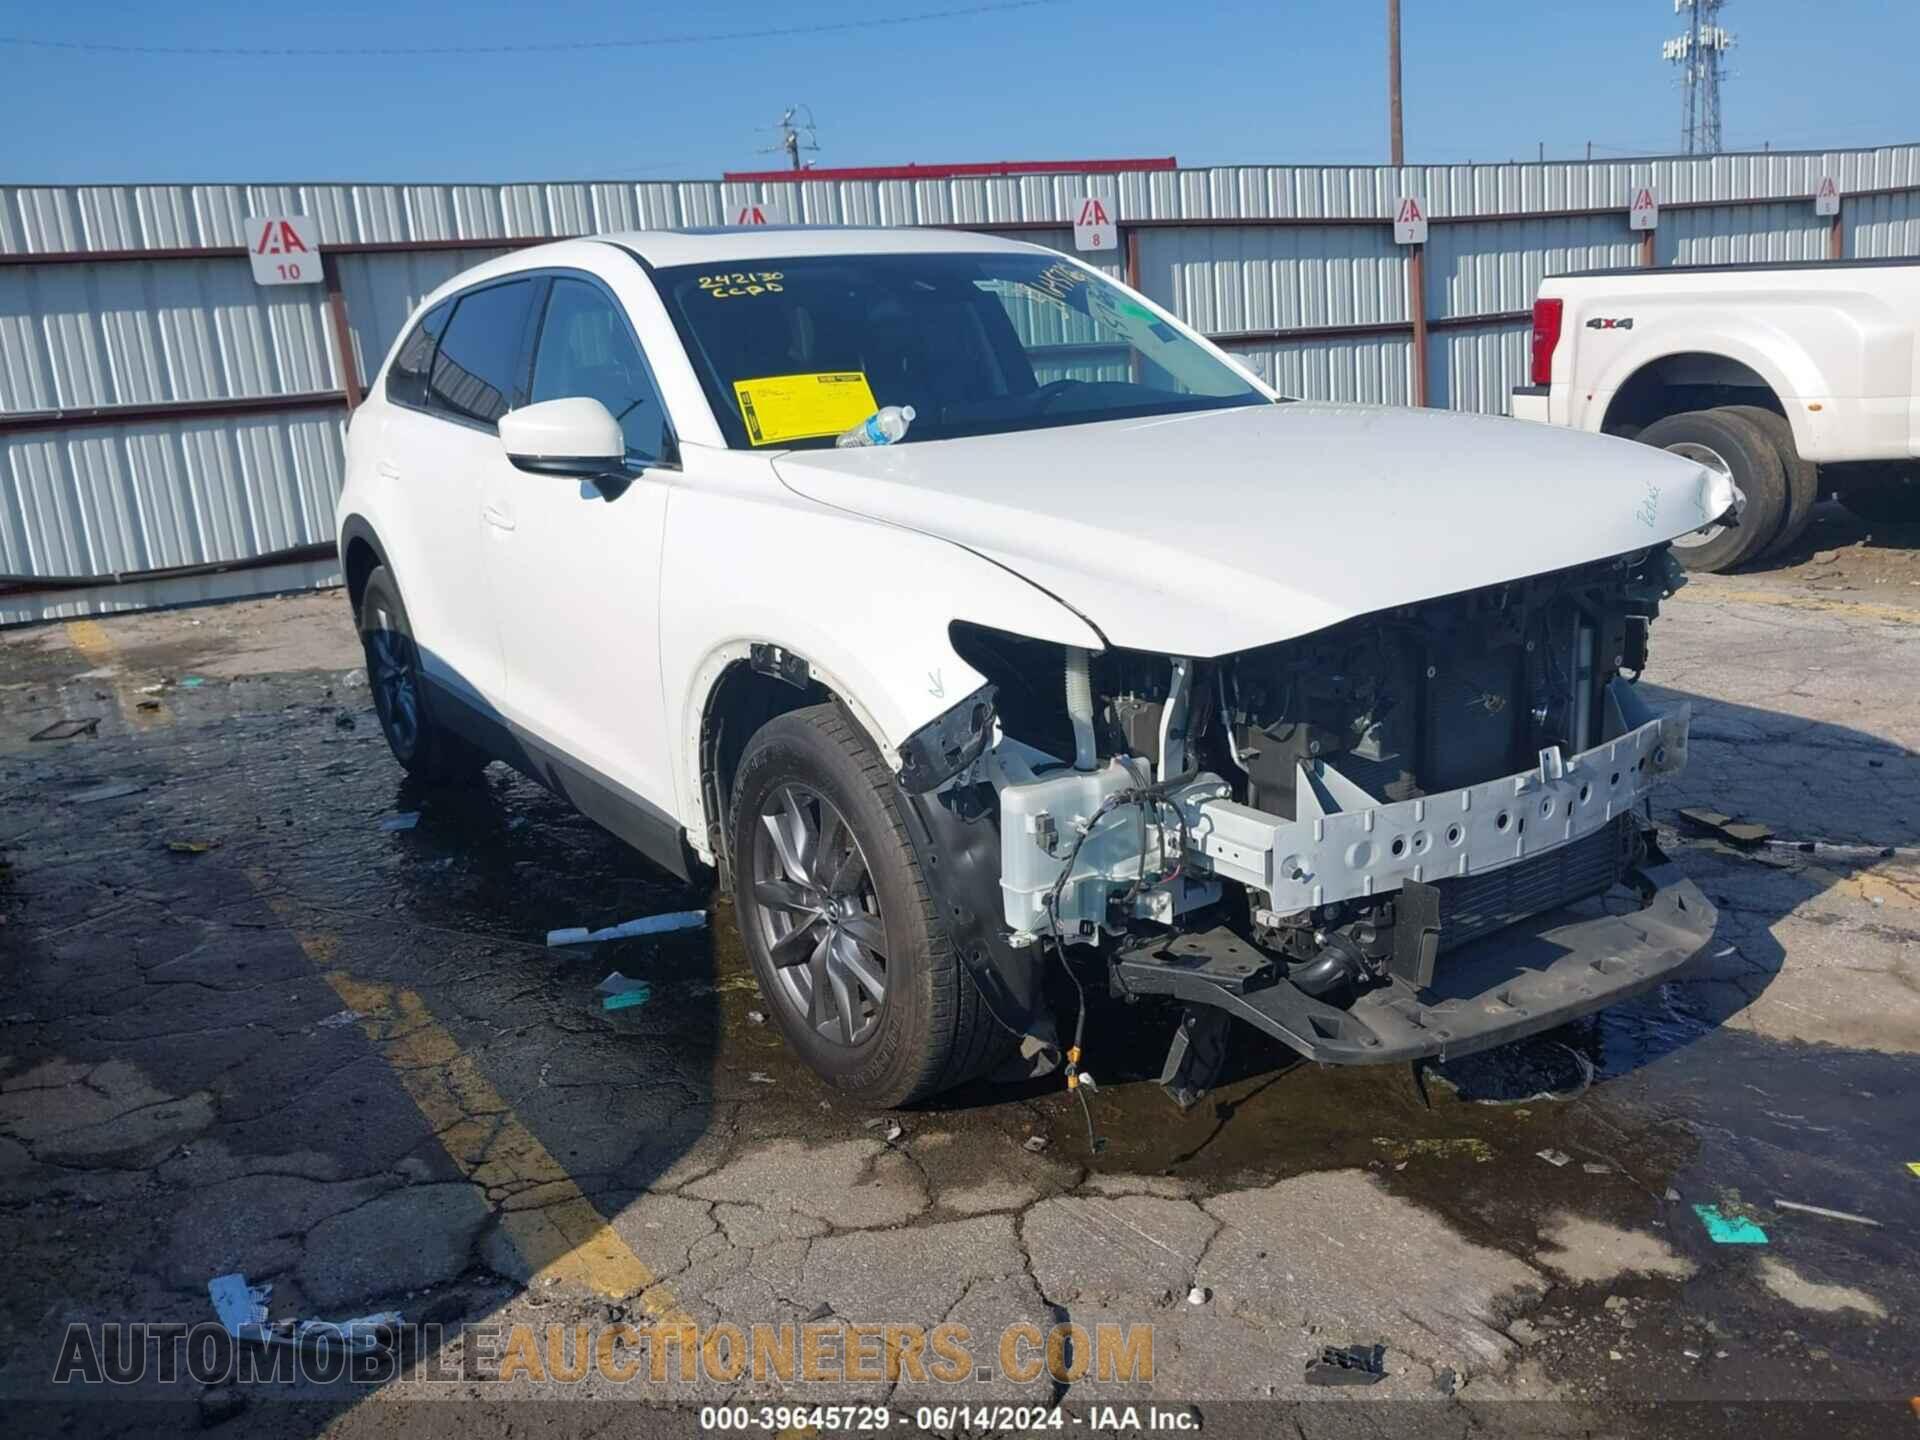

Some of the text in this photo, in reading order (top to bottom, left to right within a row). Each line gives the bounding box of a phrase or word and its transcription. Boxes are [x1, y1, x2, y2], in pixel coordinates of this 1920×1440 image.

[1092, 233, 1101, 247] 8
[1407, 228, 1416, 240] 7
[276, 263, 301, 281] 10
